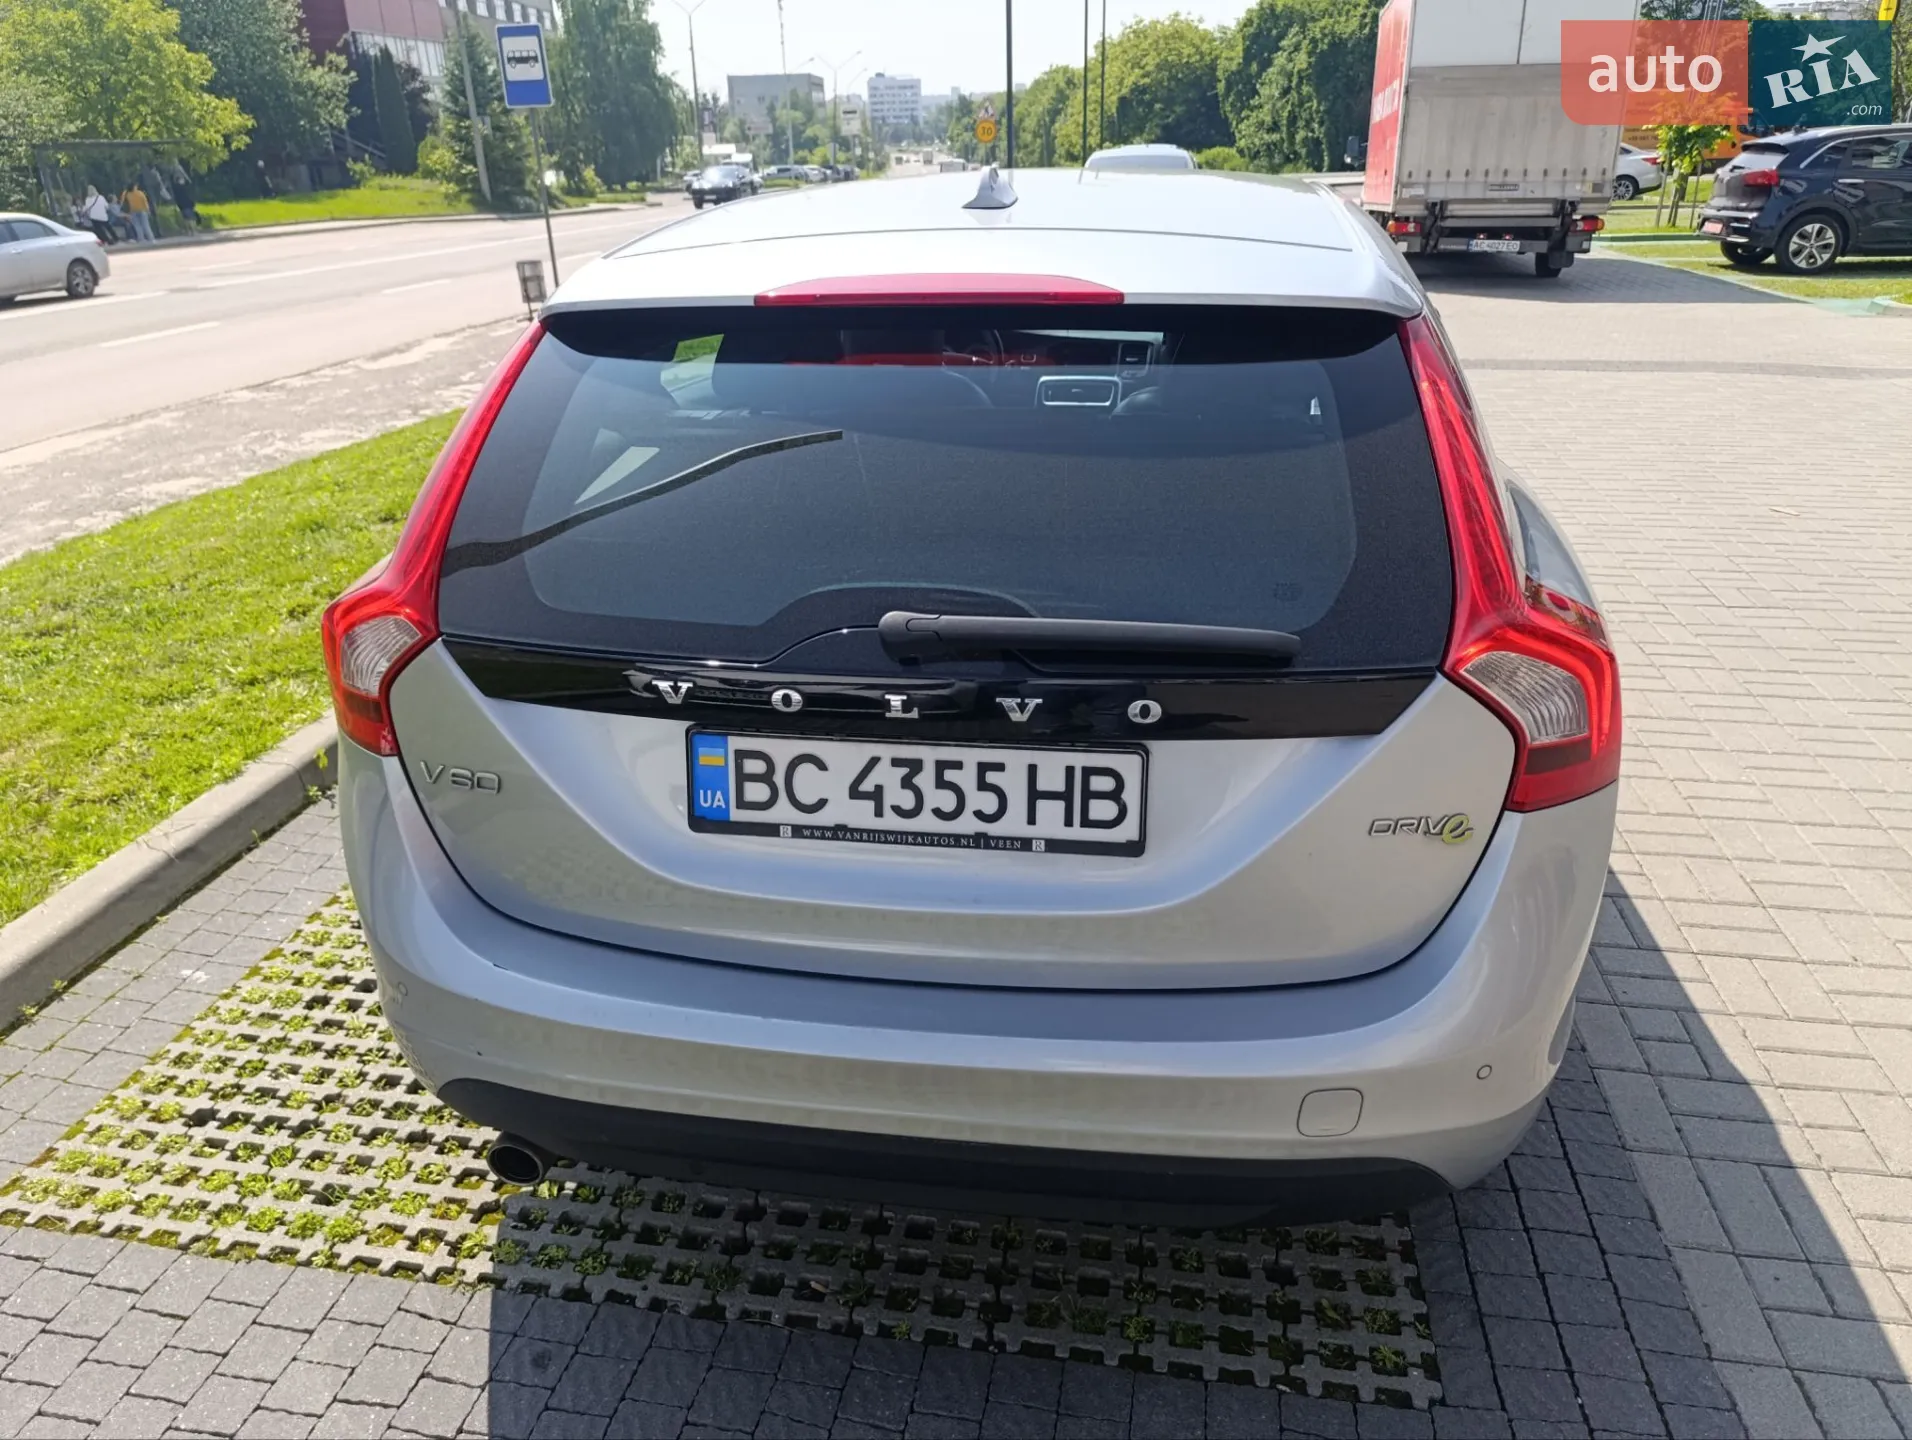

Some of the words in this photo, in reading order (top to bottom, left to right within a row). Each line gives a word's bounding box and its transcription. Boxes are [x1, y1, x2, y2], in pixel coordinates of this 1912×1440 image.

[652, 679, 1163, 724] VOLVO
[420, 760, 502, 796] V60
[734, 749, 829, 815] BC
[848, 756, 1008, 824] 4355
[1026, 763, 1129, 830] HB
[699, 789, 726, 809] UA
[802, 828, 976, 847] WWW.VANRIJSWIJKAUTOS.NL
[989, 839, 1021, 850] VEEN
